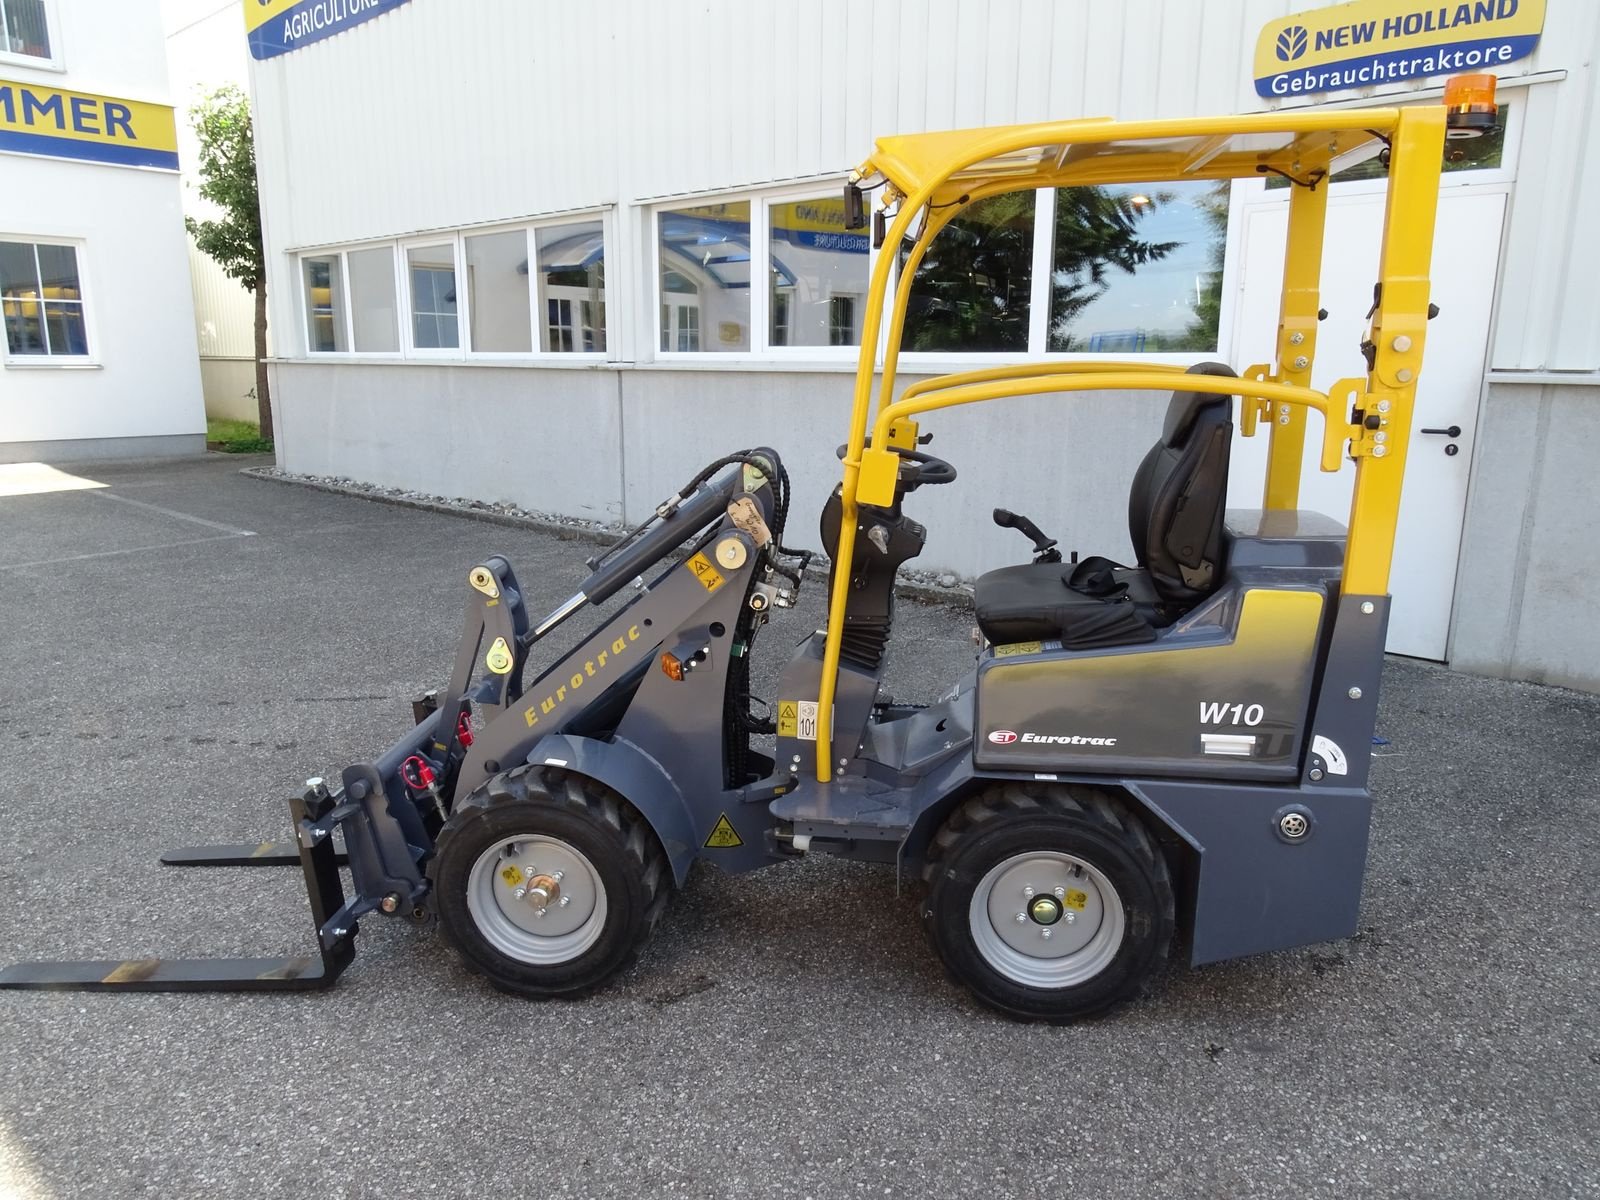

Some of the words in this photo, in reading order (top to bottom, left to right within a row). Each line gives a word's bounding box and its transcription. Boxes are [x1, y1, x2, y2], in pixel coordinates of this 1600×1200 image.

[284, 0, 379, 43] AGRICULTU
[1315, 21, 1377, 51] NEW
[1382, 0, 1518, 40] HOLLAND
[1271, 44, 1512, 94] Gebrauchttraktore
[524, 624, 641, 728] Eurotrac
[800, 718, 815, 737] 101
[1200, 701, 1264, 726] W10
[1020, 732, 1117, 746] Eurotrac
